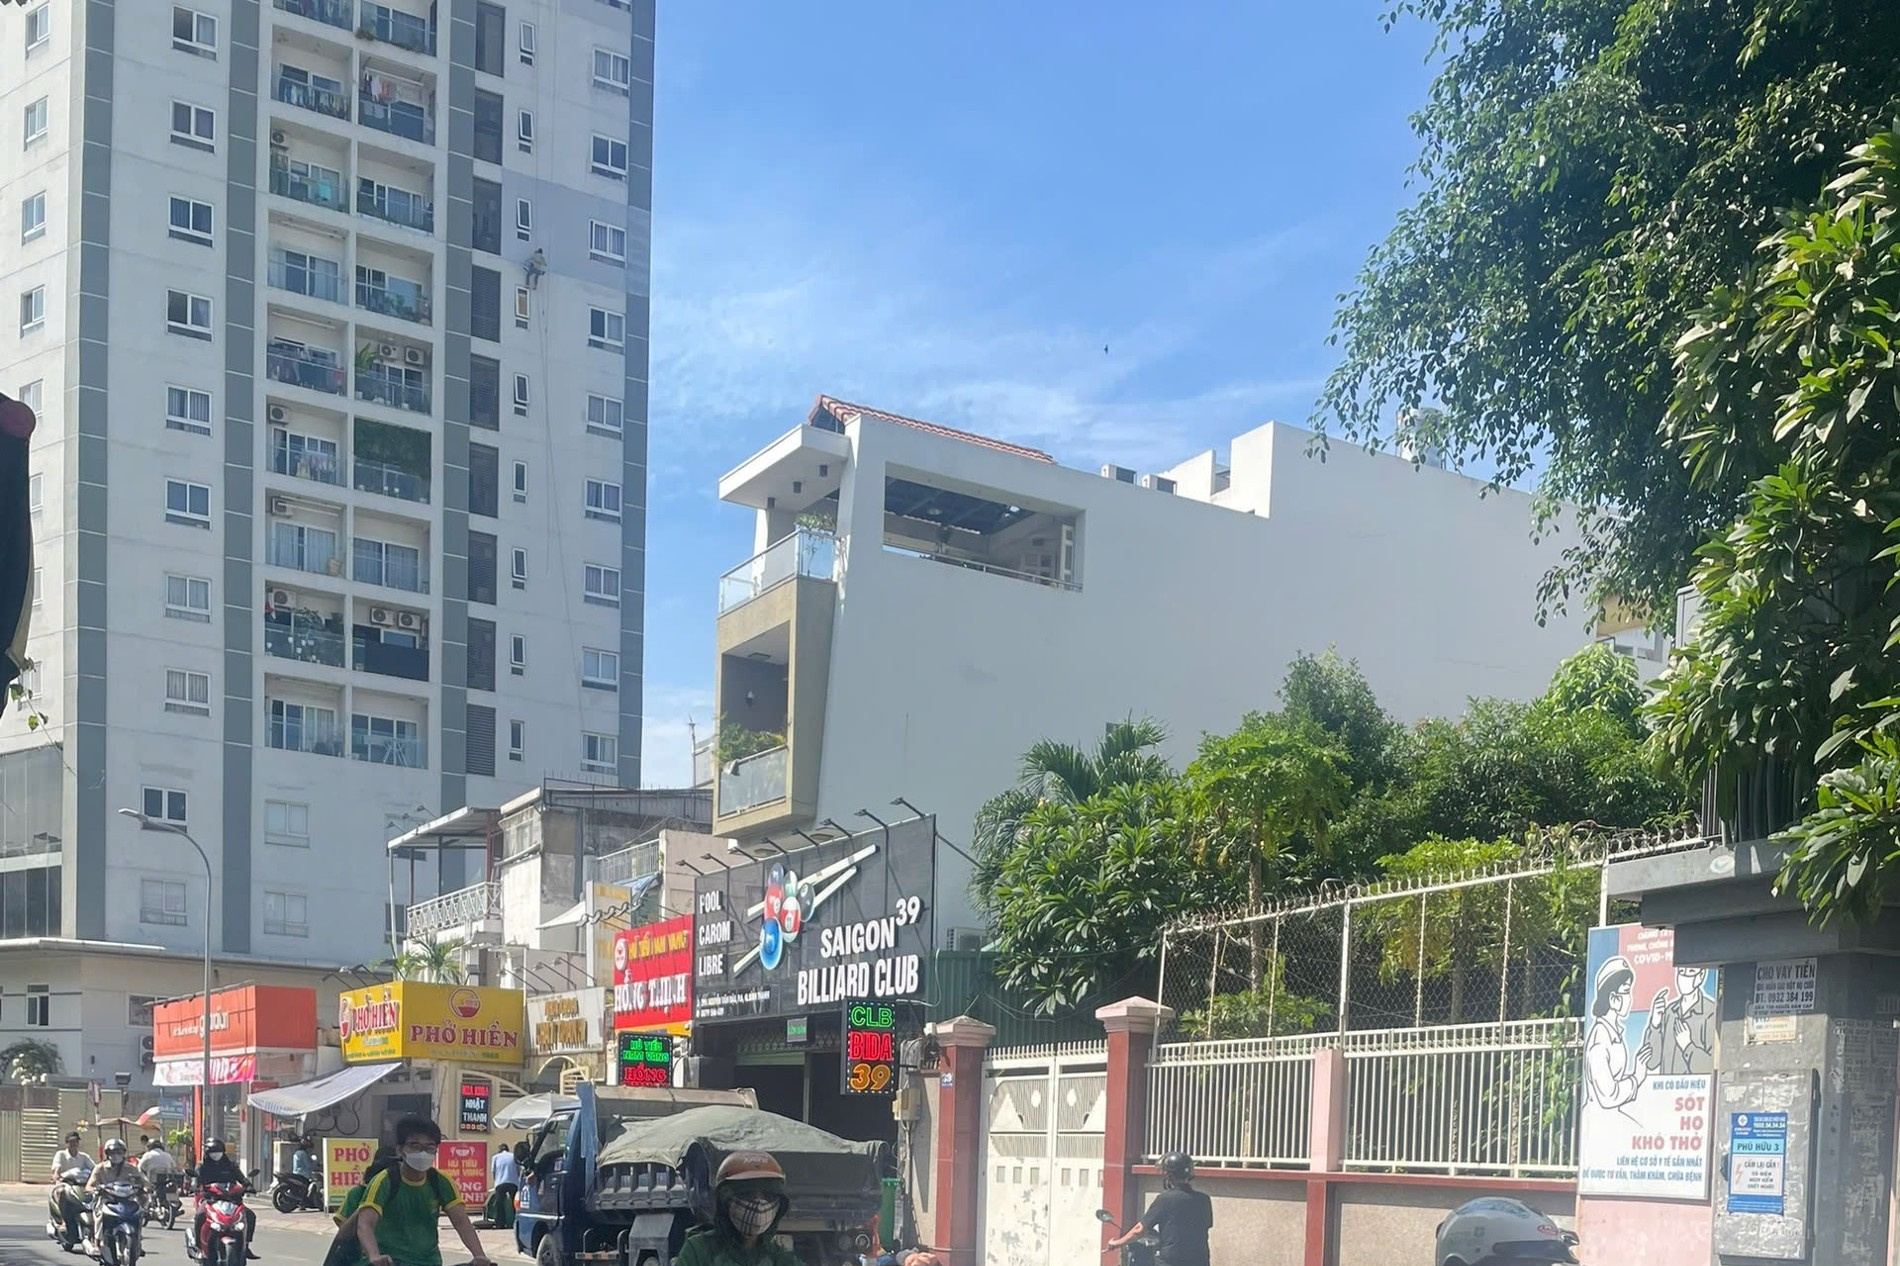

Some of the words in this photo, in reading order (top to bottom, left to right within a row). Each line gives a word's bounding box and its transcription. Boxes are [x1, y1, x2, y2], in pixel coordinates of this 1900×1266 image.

[895, 895, 921, 927] 39
[699, 920, 731, 946] CAROM
[820, 916, 895, 959] SAIGON
[698, 953, 723, 977] LIBRE
[797, 961, 870, 1005] BILLIARD
[874, 954, 919, 997] CLUB
[851, 1006, 893, 1028] CLB
[411, 1018, 457, 1045] PHỞ
[461, 1020, 519, 1049] HIỀN
[850, 1033, 893, 1061] BIDA
[851, 1064, 891, 1090] 39
[1674, 1092, 1705, 1112] SỐT
[463, 1112, 487, 1123] THANH
[1680, 1116, 1704, 1130] HO
[1632, 1132, 1665, 1150] KHÓ
[1670, 1131, 1703, 1151] THỞ
